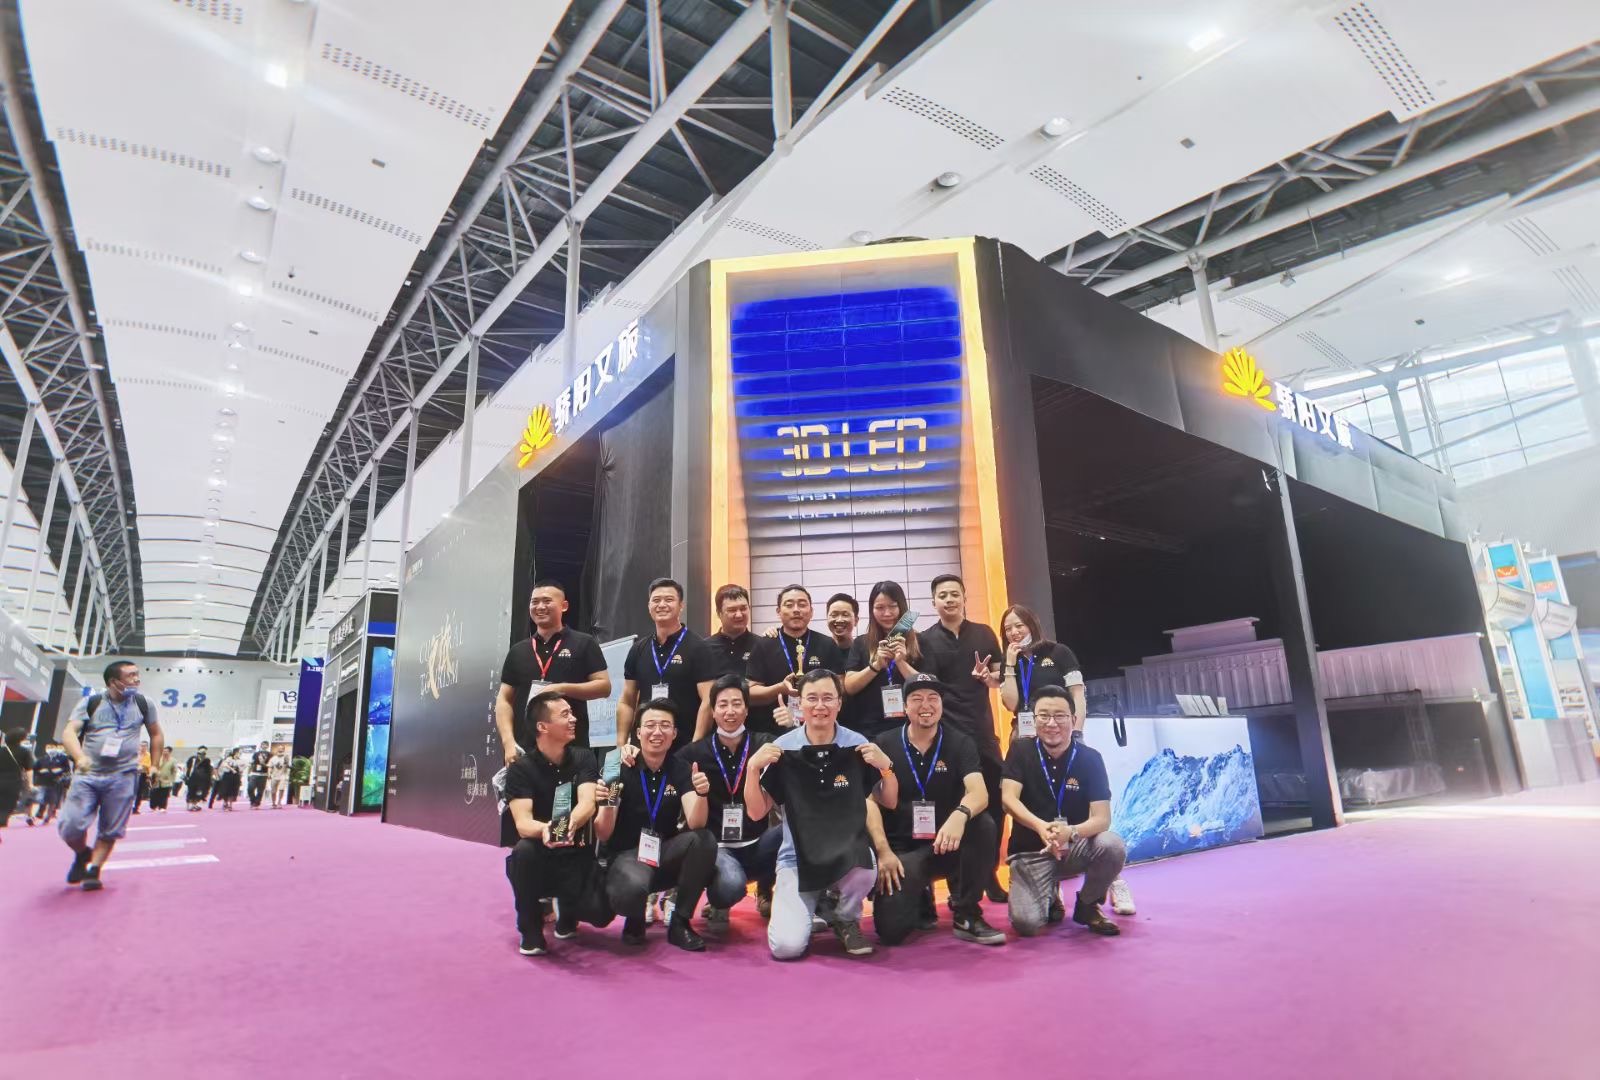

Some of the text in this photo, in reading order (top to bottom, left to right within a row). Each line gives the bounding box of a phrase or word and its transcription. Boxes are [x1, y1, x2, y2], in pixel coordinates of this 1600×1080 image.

[777, 417, 927, 477] 3D LED
[161, 688, 207, 708] 3.2
